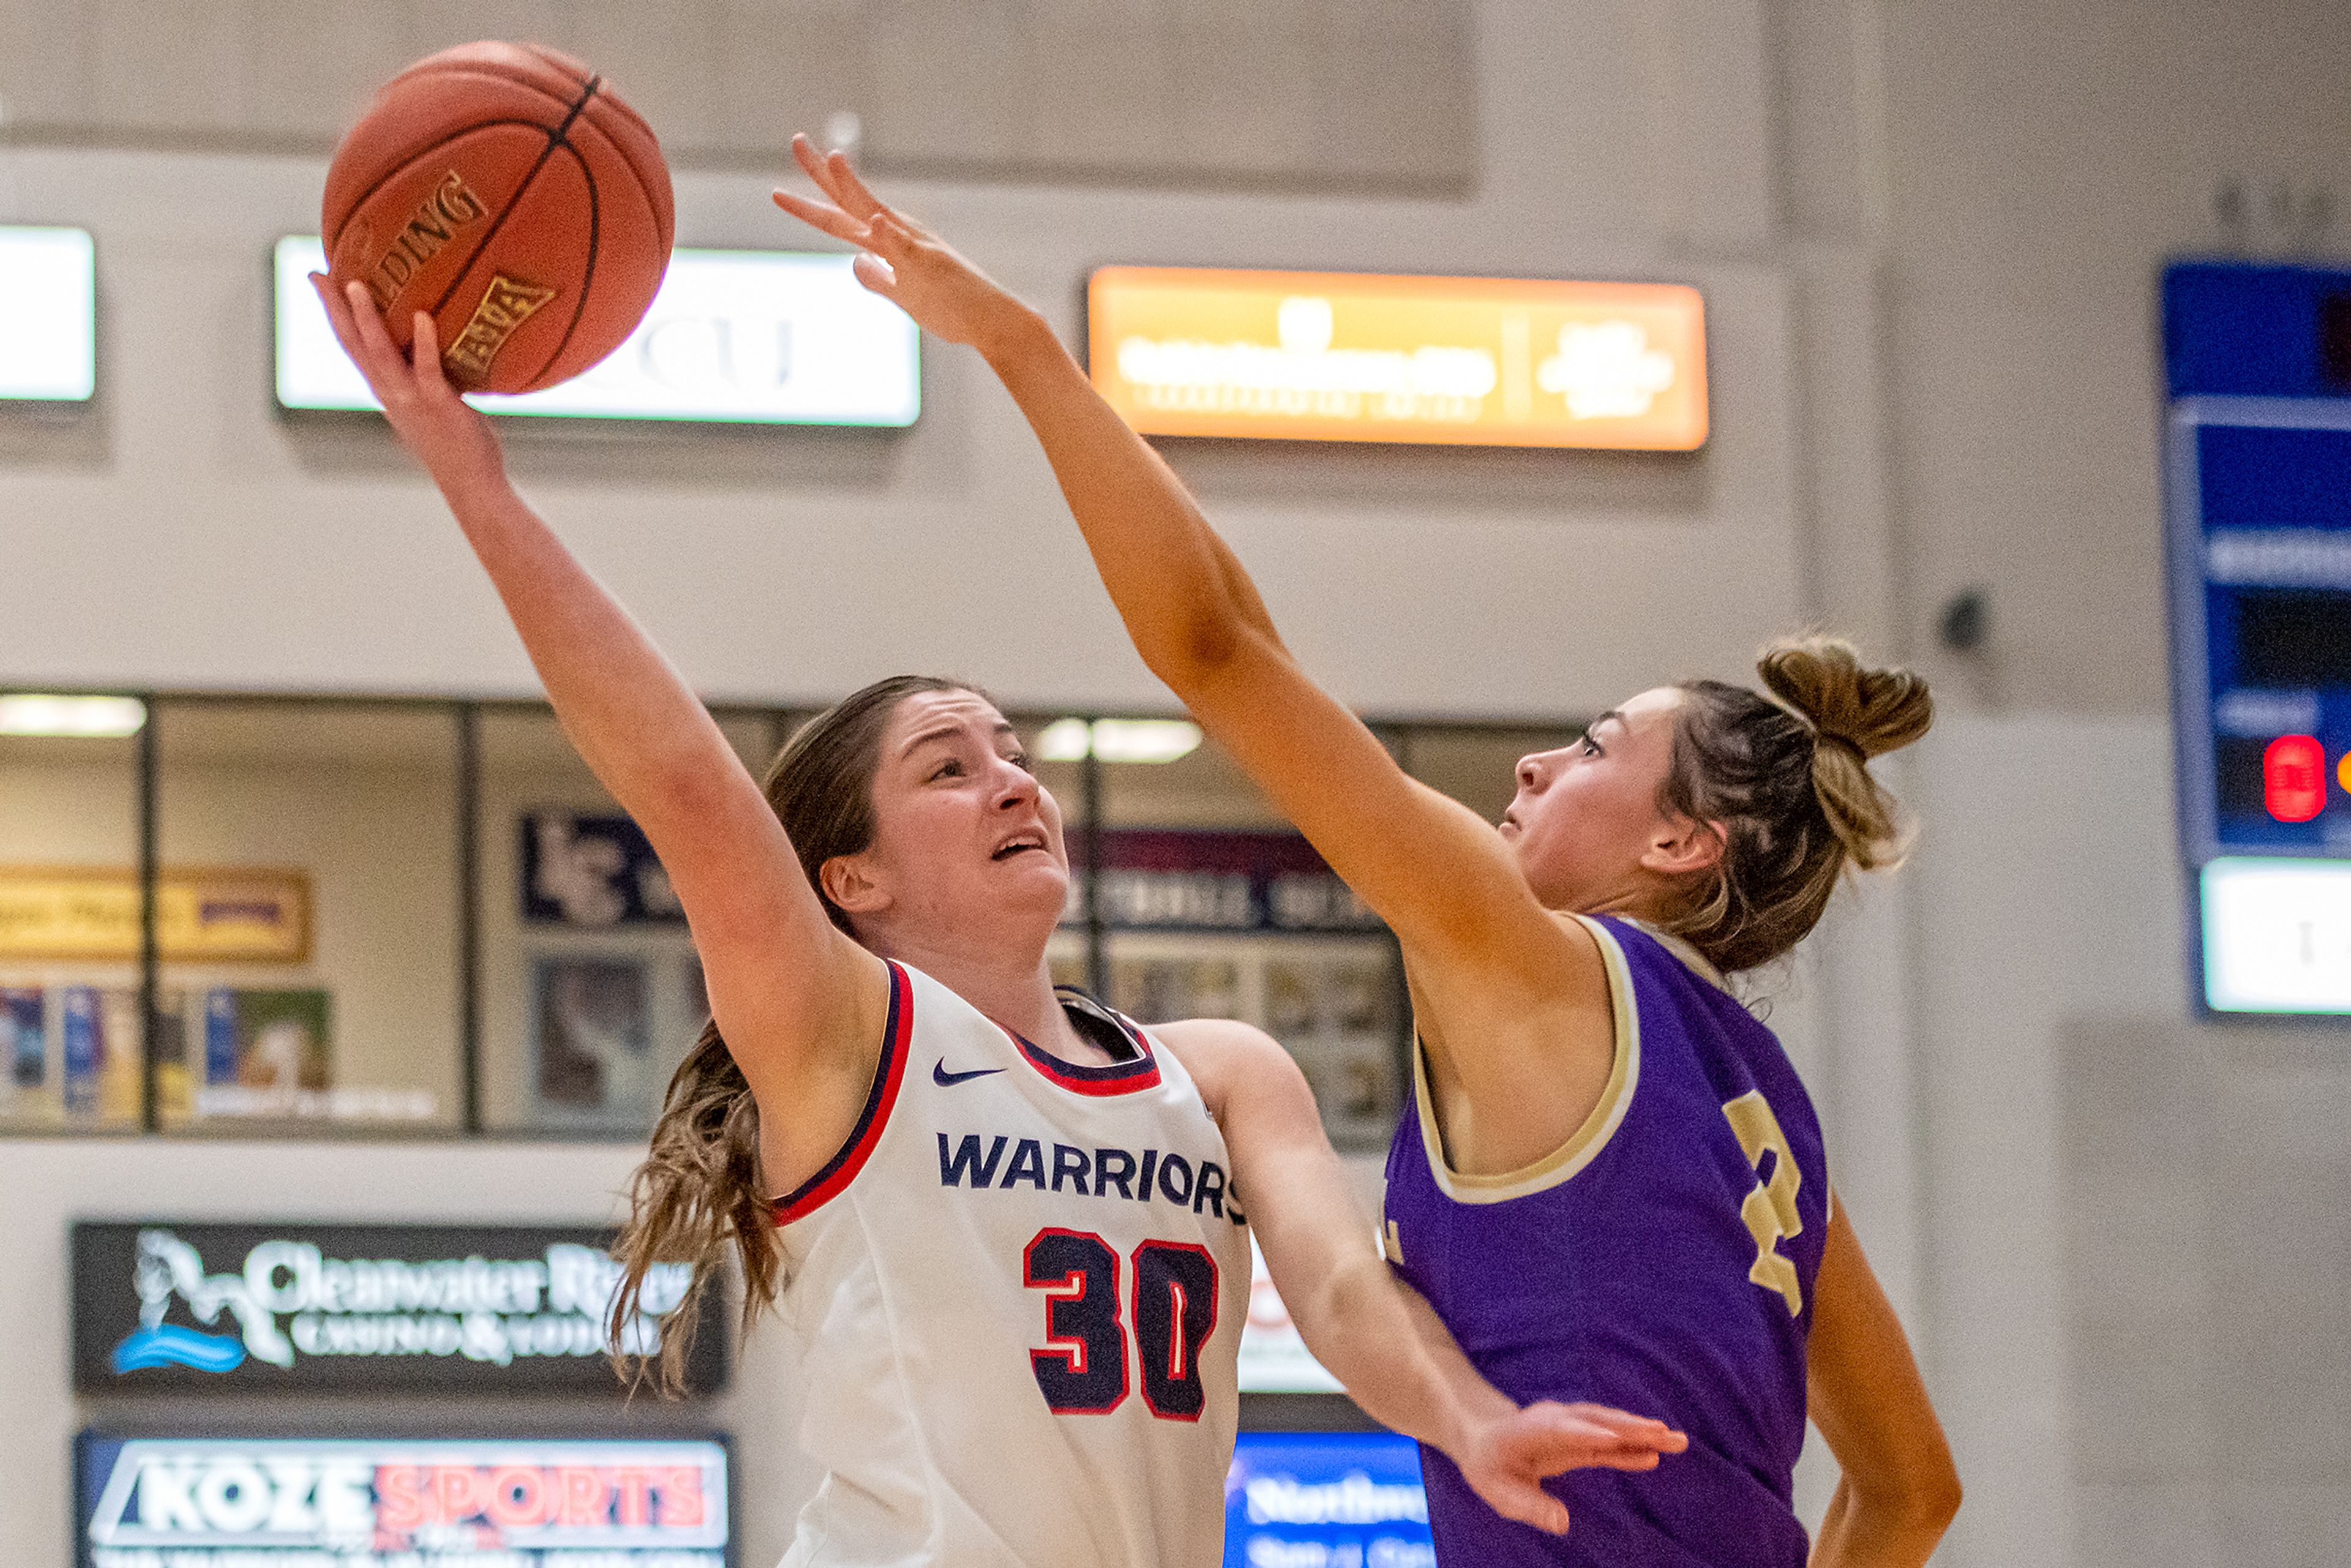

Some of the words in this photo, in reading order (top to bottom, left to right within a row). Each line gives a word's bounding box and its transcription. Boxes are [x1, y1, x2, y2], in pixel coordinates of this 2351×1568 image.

[367, 170, 489, 315] LDING
[1721, 1089, 1803, 1318] 2
[242, 1239, 549, 1315] Clearwater
[1023, 1226, 1220, 1423] 30
[138, 1457, 373, 1531] KOZE
[373, 1462, 704, 1528] SPORTS
